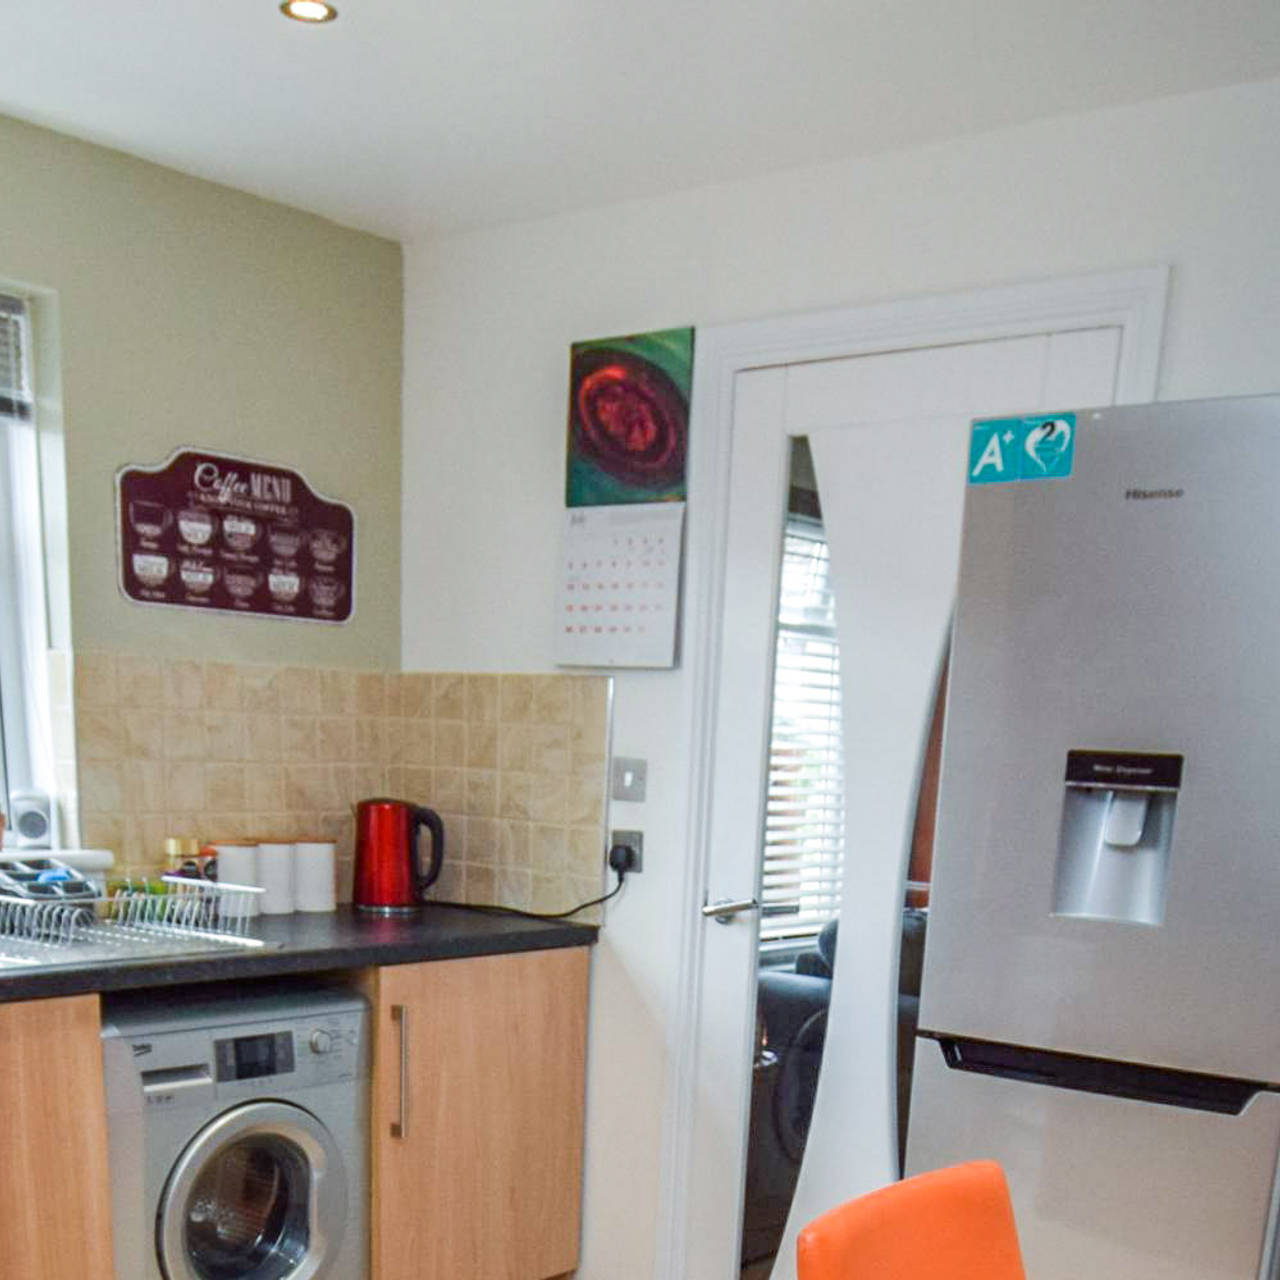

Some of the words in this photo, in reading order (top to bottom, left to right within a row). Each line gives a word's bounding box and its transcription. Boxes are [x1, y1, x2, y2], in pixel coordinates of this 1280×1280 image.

[194, 462, 248, 504] Coffee
[250, 472, 291, 503] MENU
[1124, 488, 1185, 501] Hisense
